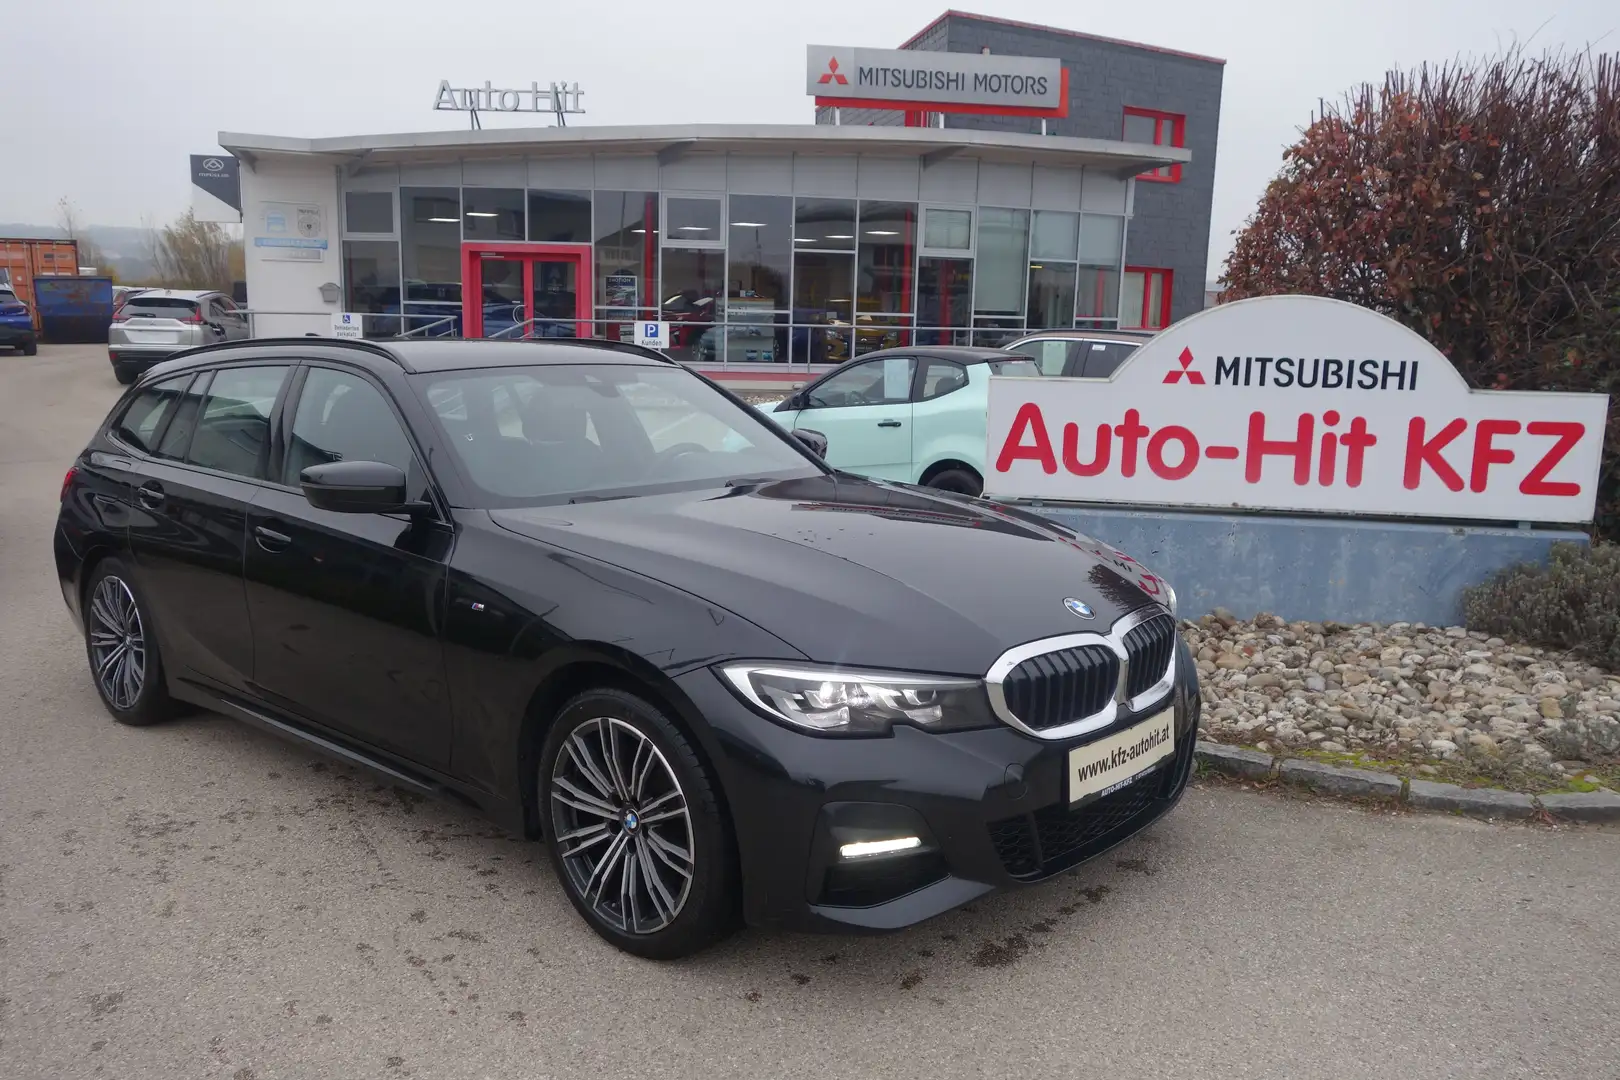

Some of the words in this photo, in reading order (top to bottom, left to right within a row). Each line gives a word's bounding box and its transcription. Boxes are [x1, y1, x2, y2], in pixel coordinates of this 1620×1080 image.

[432, 79, 521, 112] Auto
[531, 80, 586, 113] Hit
[858, 65, 965, 92] MITSUBISHI
[973, 72, 1049, 96] MOTORS
[641, 339, 662, 347] Kunden
[647, 324, 656, 337] P
[1215, 355, 1419, 391] MITSUBISHI
[995, 401, 1378, 488] Auto-Hit
[1402, 416, 1587, 496] KFZ
[1078, 722, 1170, 782] www.kfz-autohit.at
[1101, 777, 1133, 798] AUTO-HIT-KFZ
